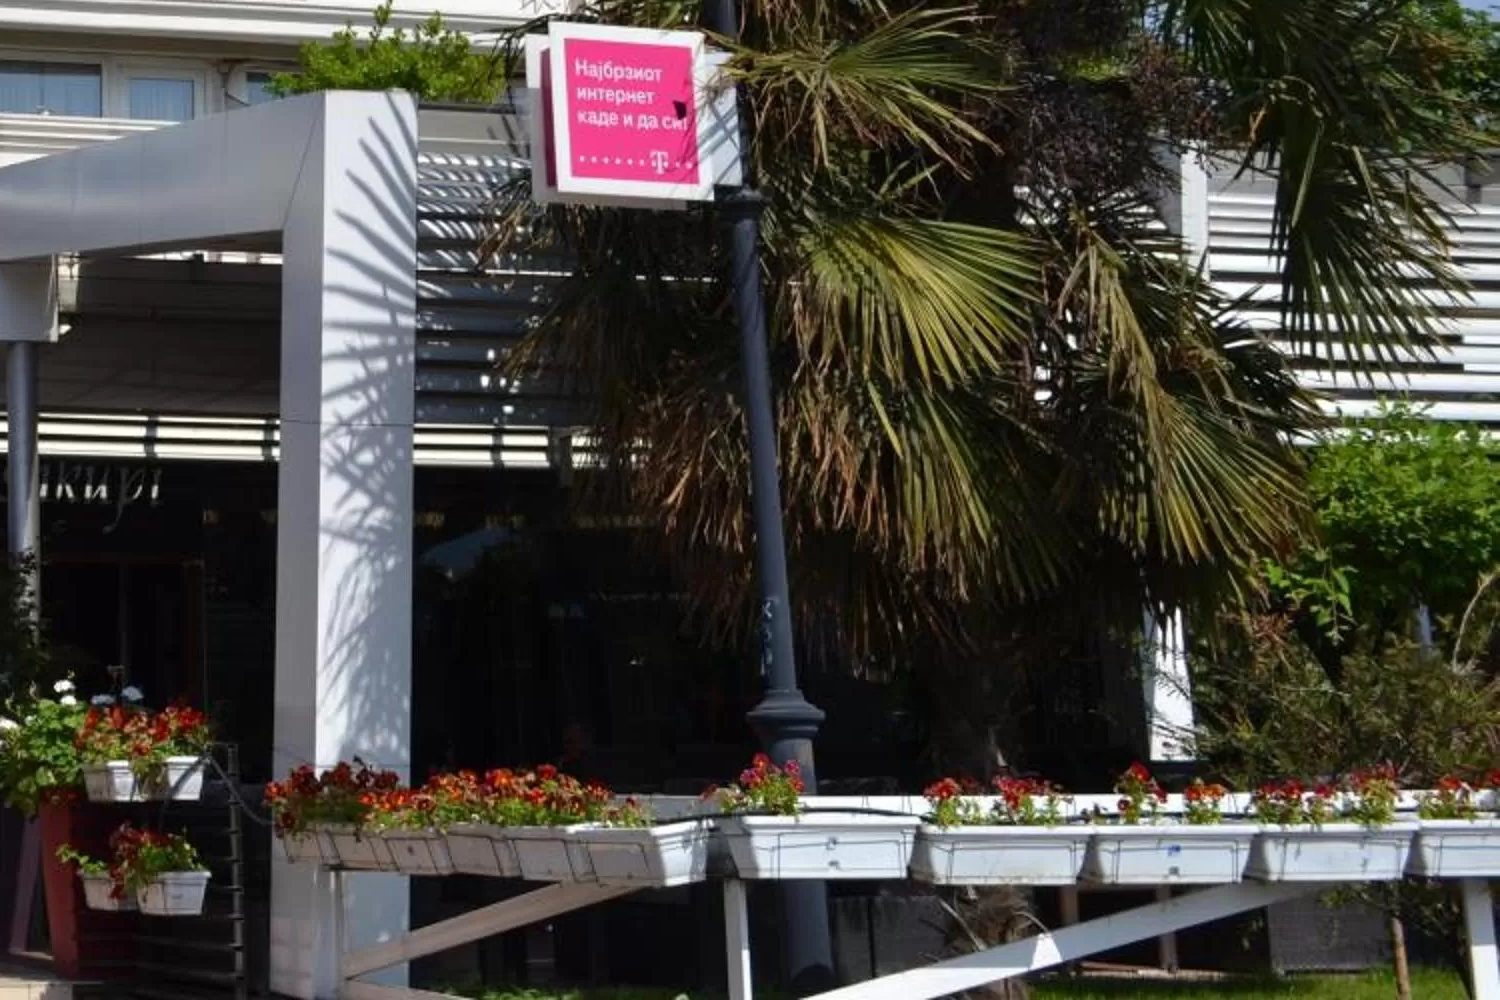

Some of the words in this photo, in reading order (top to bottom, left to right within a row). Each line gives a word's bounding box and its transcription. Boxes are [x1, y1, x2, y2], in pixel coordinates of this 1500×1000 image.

[575, 60, 662, 82] Најбрзиот
[577, 87, 655, 105] интернет
[578, 110, 619, 127] каде
[623, 114, 633, 127] и
[637, 113, 659, 130] да
